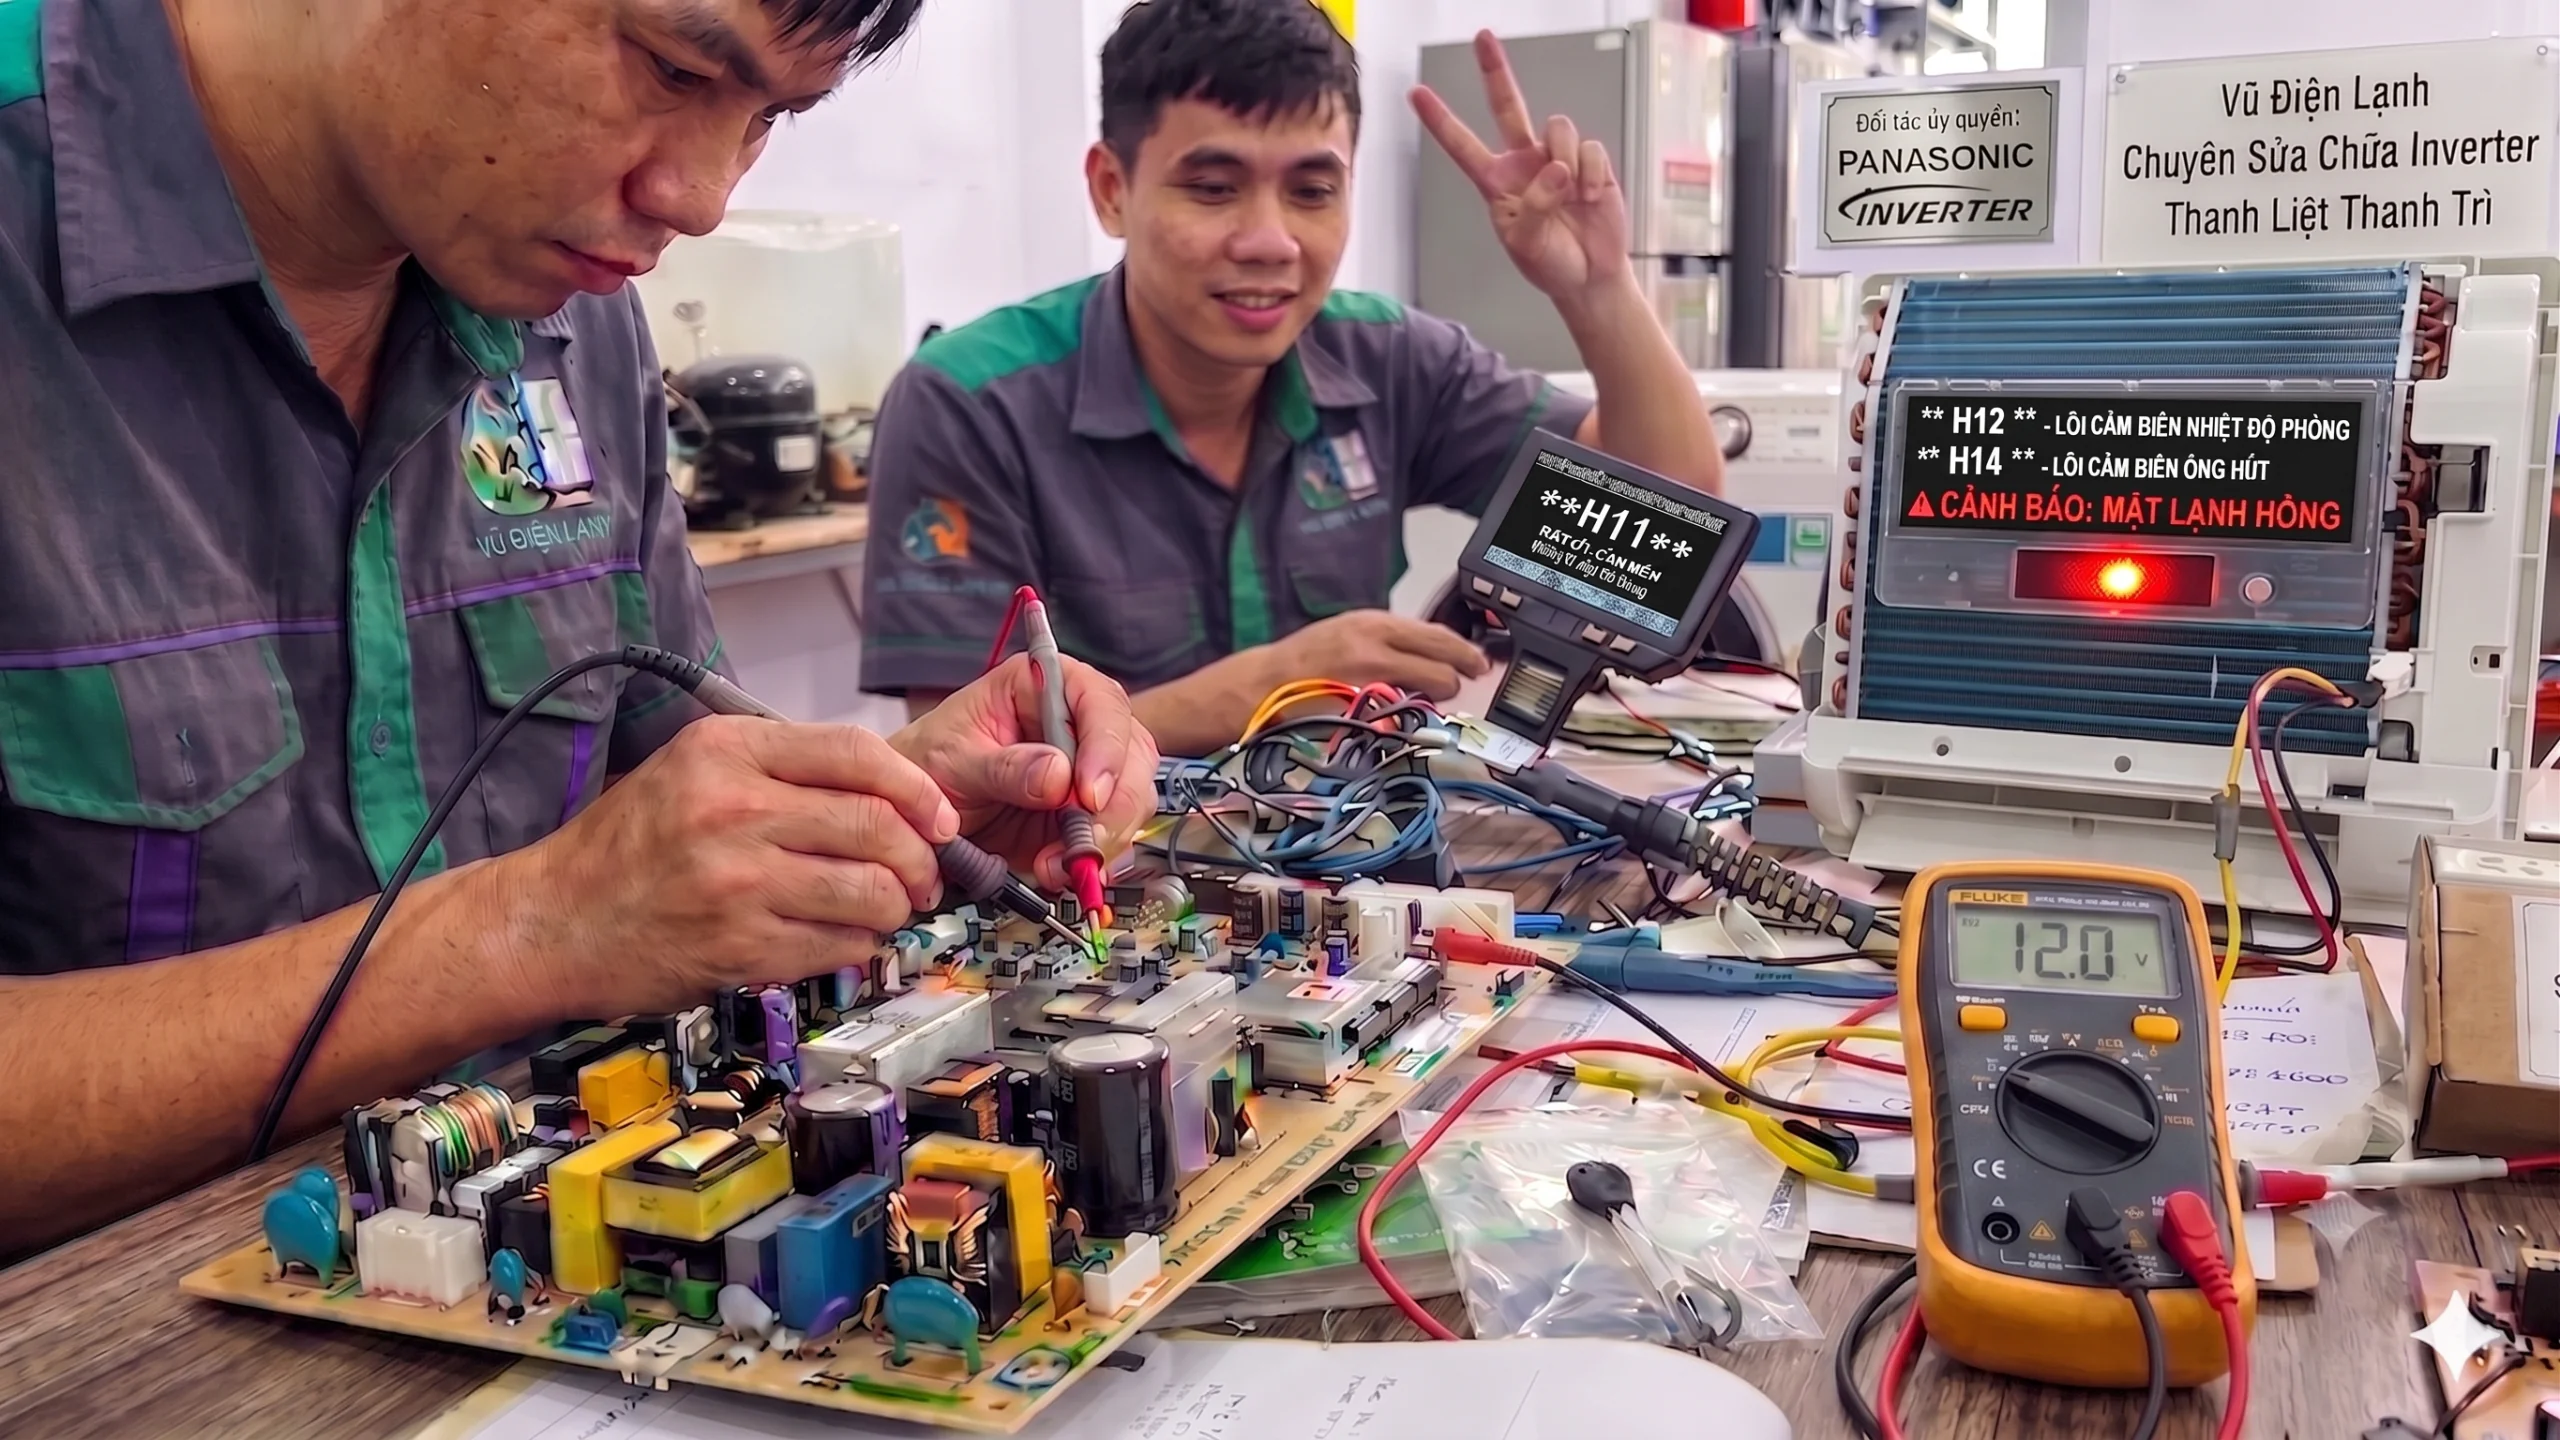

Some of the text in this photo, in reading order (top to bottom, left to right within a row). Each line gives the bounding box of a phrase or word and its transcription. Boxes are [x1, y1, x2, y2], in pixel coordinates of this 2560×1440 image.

[2221, 72, 2429, 122] Vũ Điện Lạnh
[1856, 103, 2020, 134] Đối tác ủy quyền:
[1838, 143, 2034, 176] PANASONIC
[2123, 129, 2540, 184] Chuyên Sửa Chữa Inverter
[1856, 199, 2033, 226] INVERTER
[2165, 188, 2492, 240] Thanh Liệt Thanh Trì
[1952, 406, 2005, 434] H12
[2091, 410, 2132, 436] CẢM
[2187, 412, 2244, 443] NHIỆT
[2247, 414, 2276, 444] ĐỘ
[2281, 414, 2350, 441] PHÒNG
[1949, 446, 2002, 475] H14
[2088, 452, 2129, 478] CẢM
[1940, 484, 2017, 520] CẢNH
[2025, 483, 2092, 522] BÁO:
[2169, 498, 2248, 533] LẠNH
[1959, 891, 2025, 904] FLUKE
[2014, 922, 2114, 981] 12.0
[1972, 1159, 2007, 1179] CE
